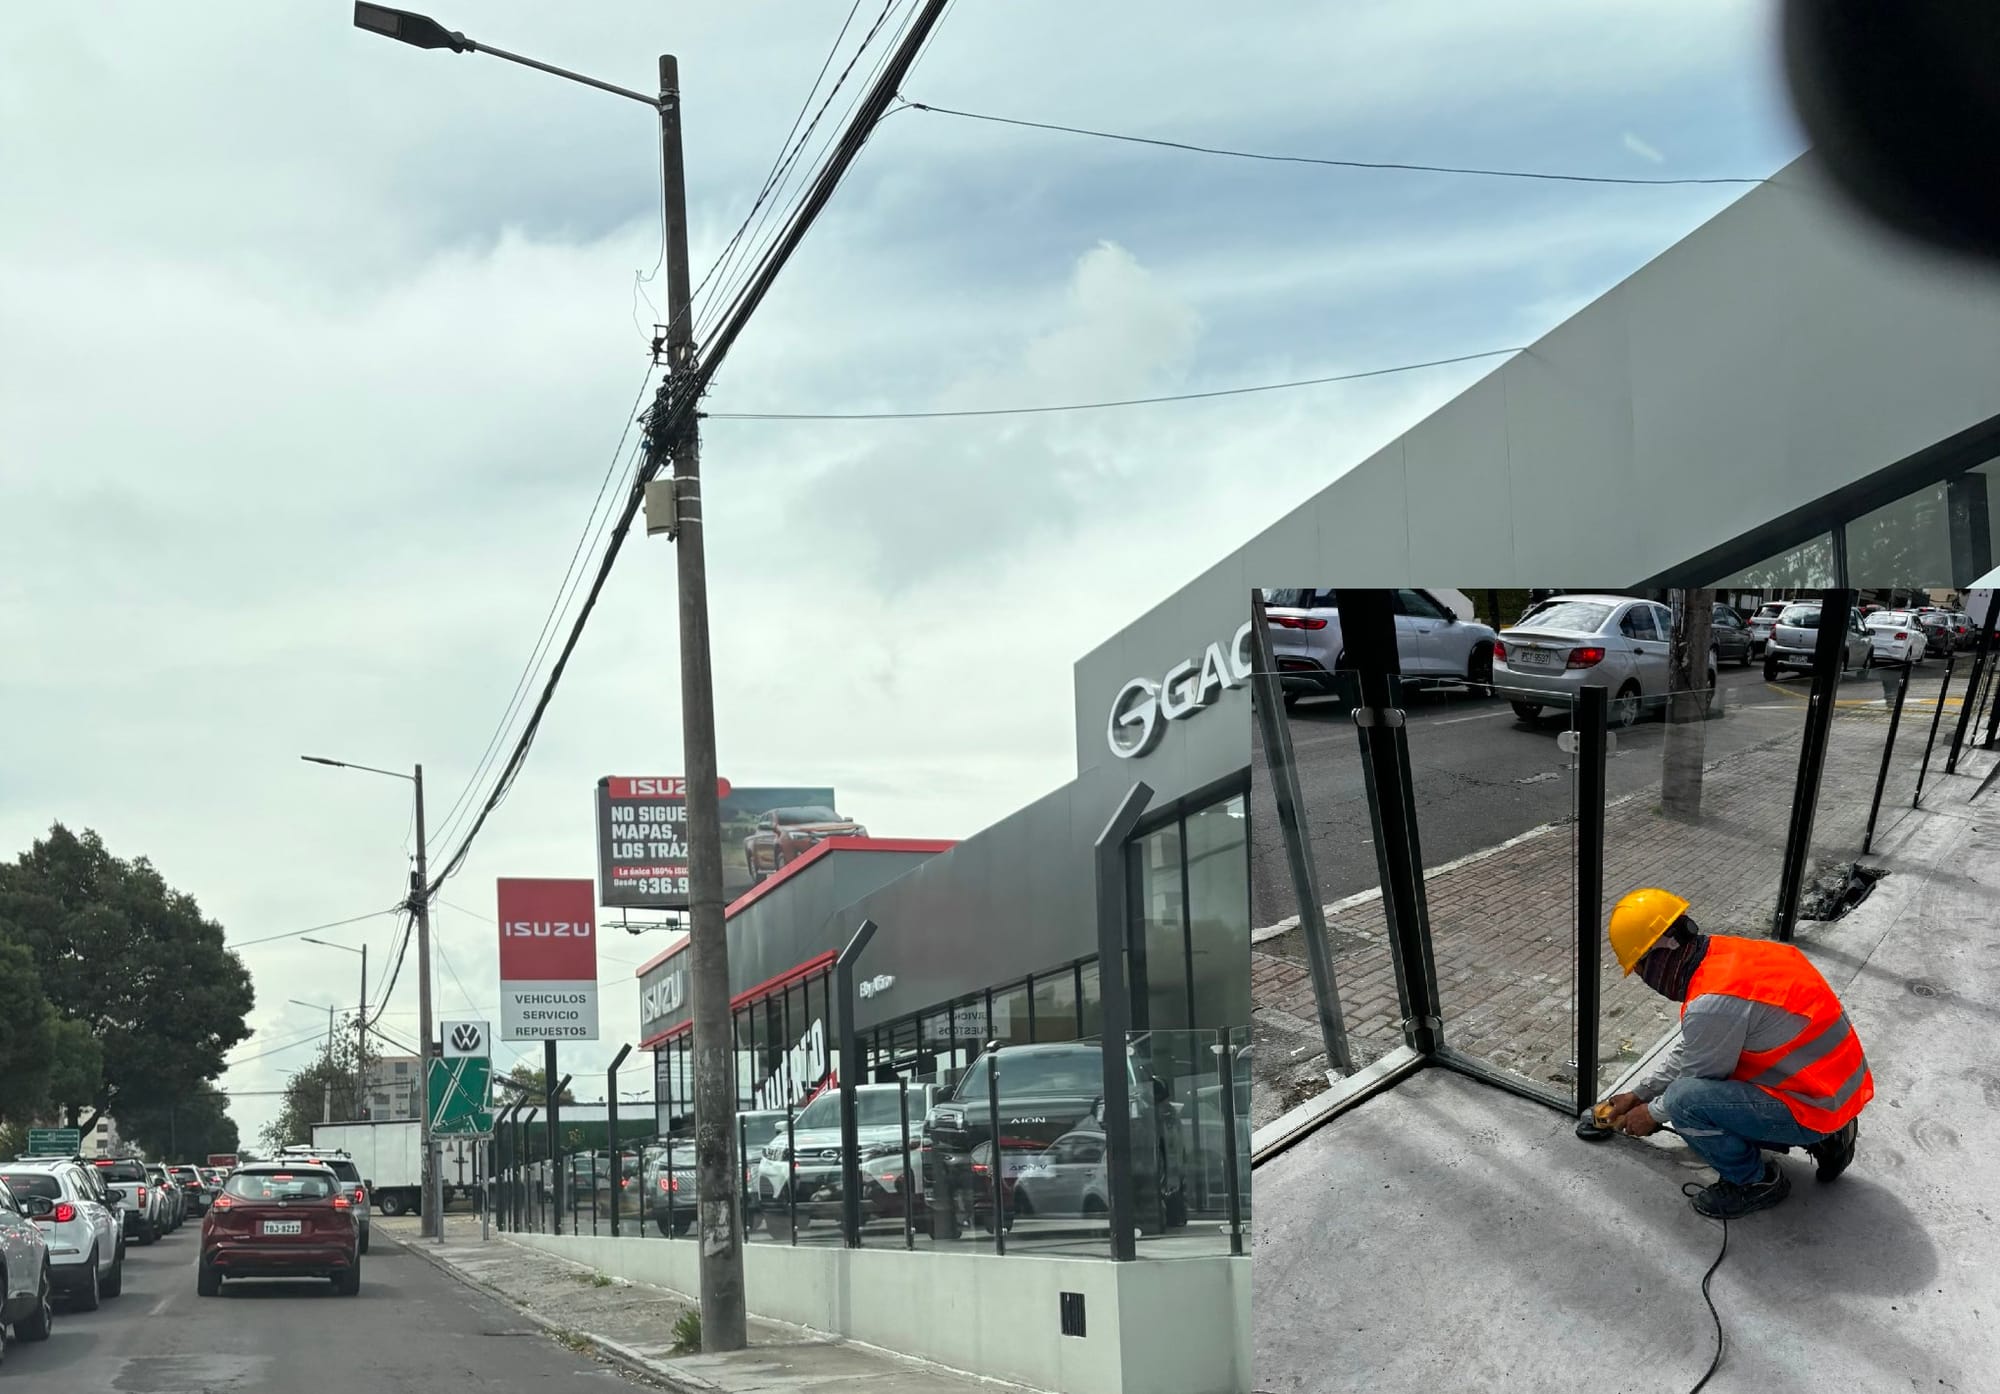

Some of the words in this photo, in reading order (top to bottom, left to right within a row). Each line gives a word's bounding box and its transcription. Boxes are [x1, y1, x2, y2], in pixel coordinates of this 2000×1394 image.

[630, 779, 686, 795] ISUZ
[611, 806, 634, 822] NO
[611, 823, 678, 842] MAPAS,
[612, 842, 644, 859] LOS
[648, 842, 688, 859] TRAZ
[613, 878, 637, 887] Desde
[638, 877, 689, 894] $36.9
[505, 921, 590, 937] ISUZU
[514, 994, 587, 1004] VEHICULOS
[641, 969, 684, 1025] ISUZU
[522, 1010, 579, 1020] SERVICIO
[515, 1026, 587, 1036] REPUESTOS
[1010, 1116, 1046, 1125] AION
